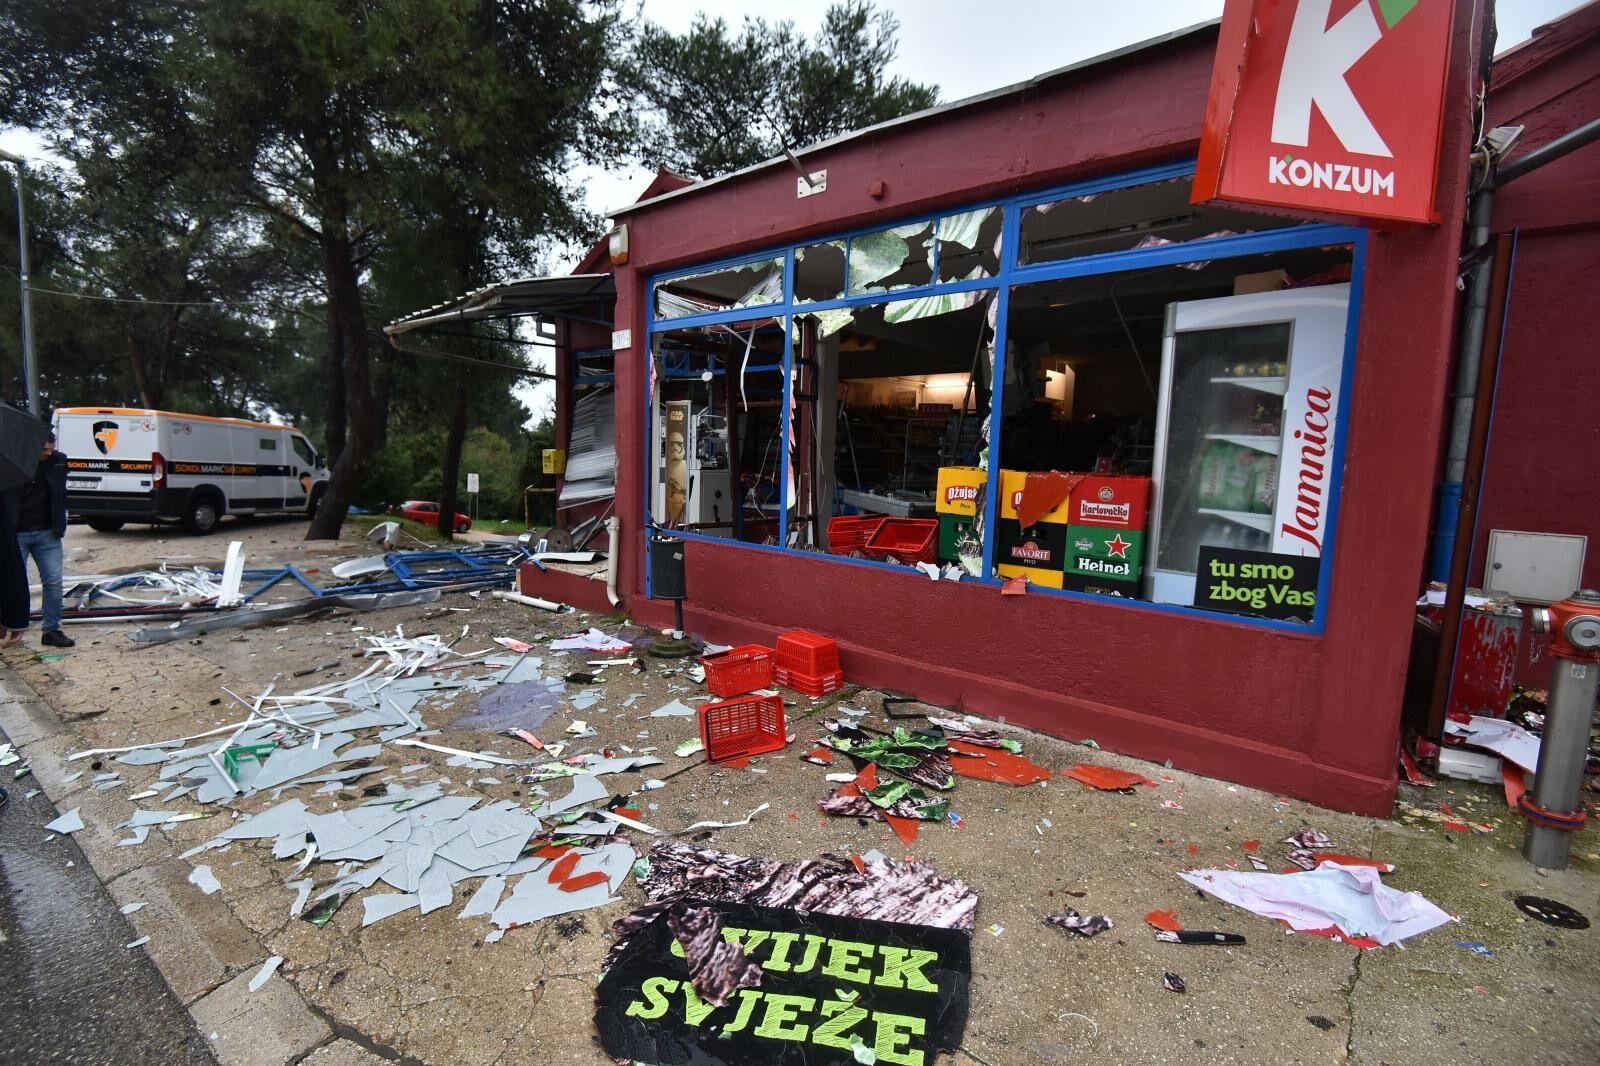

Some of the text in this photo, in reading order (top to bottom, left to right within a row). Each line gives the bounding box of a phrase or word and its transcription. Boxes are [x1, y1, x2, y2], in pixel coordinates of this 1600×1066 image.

[1271, 0, 1394, 158] K
[1269, 156, 1394, 198] KONZUM
[1281, 386, 1331, 557] Jamnica
[948, 486, 978, 500] Ožujsk
[1082, 503, 1128, 517] Karlovačko
[1013, 548, 1049, 559] FAVORIT
[1209, 559, 1294, 580] tu smo
[1209, 580, 1316, 609] zbog Vas
[670, 927, 938, 993] VIJEK
[625, 976, 926, 1066] SVJEŽE
